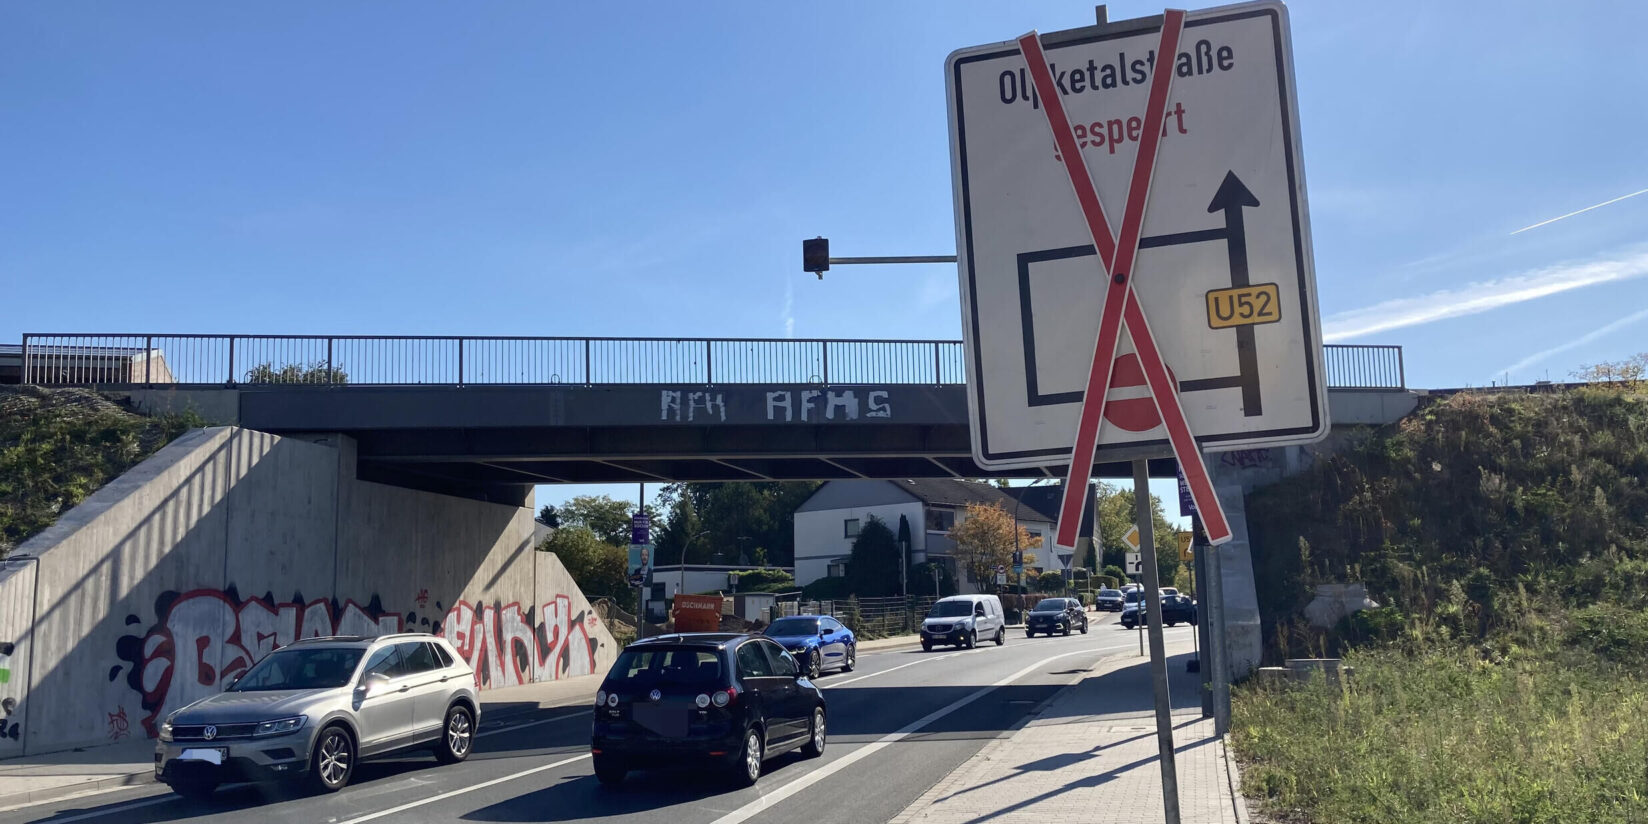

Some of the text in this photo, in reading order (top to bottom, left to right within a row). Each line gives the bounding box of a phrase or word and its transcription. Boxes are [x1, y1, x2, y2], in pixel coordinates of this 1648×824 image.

[999, 39, 1234, 110] Olketalstaße
[1054, 102, 1187, 161] espert
[1214, 291, 1273, 321] U52
[1181, 535, 1192, 543] U5
